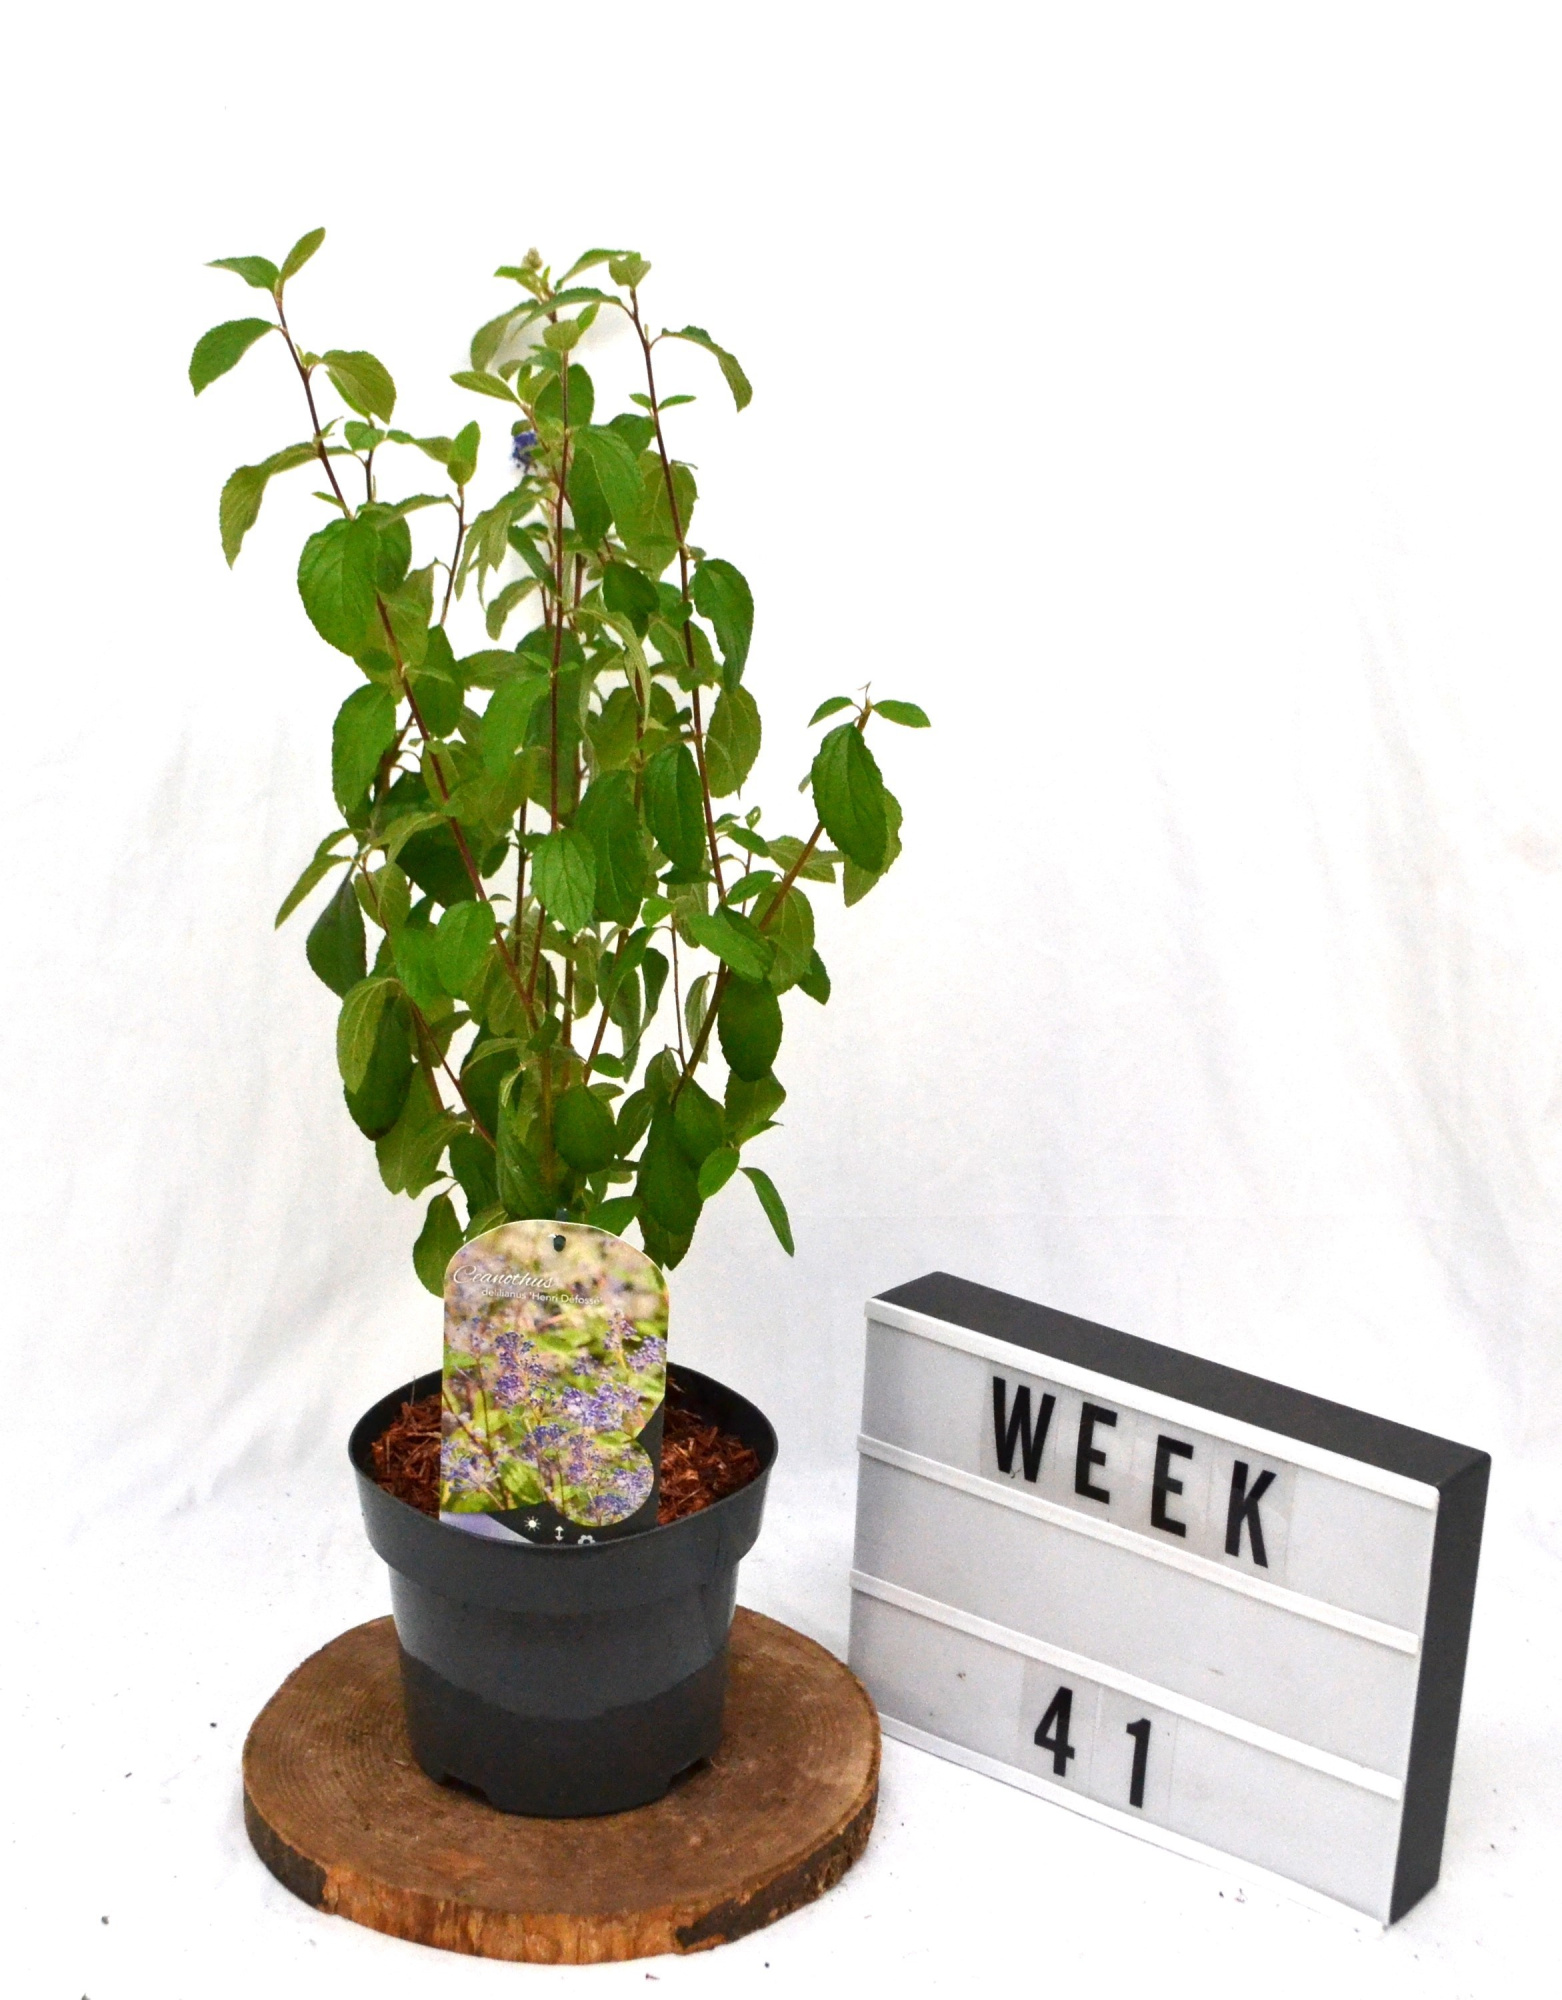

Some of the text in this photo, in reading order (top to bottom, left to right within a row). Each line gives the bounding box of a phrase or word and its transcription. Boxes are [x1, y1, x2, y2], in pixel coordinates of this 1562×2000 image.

[453, 1265, 553, 1288] Ceanothus
[993, 1376, 1276, 1568] WEEK
[1034, 1686, 1151, 1809] 41
